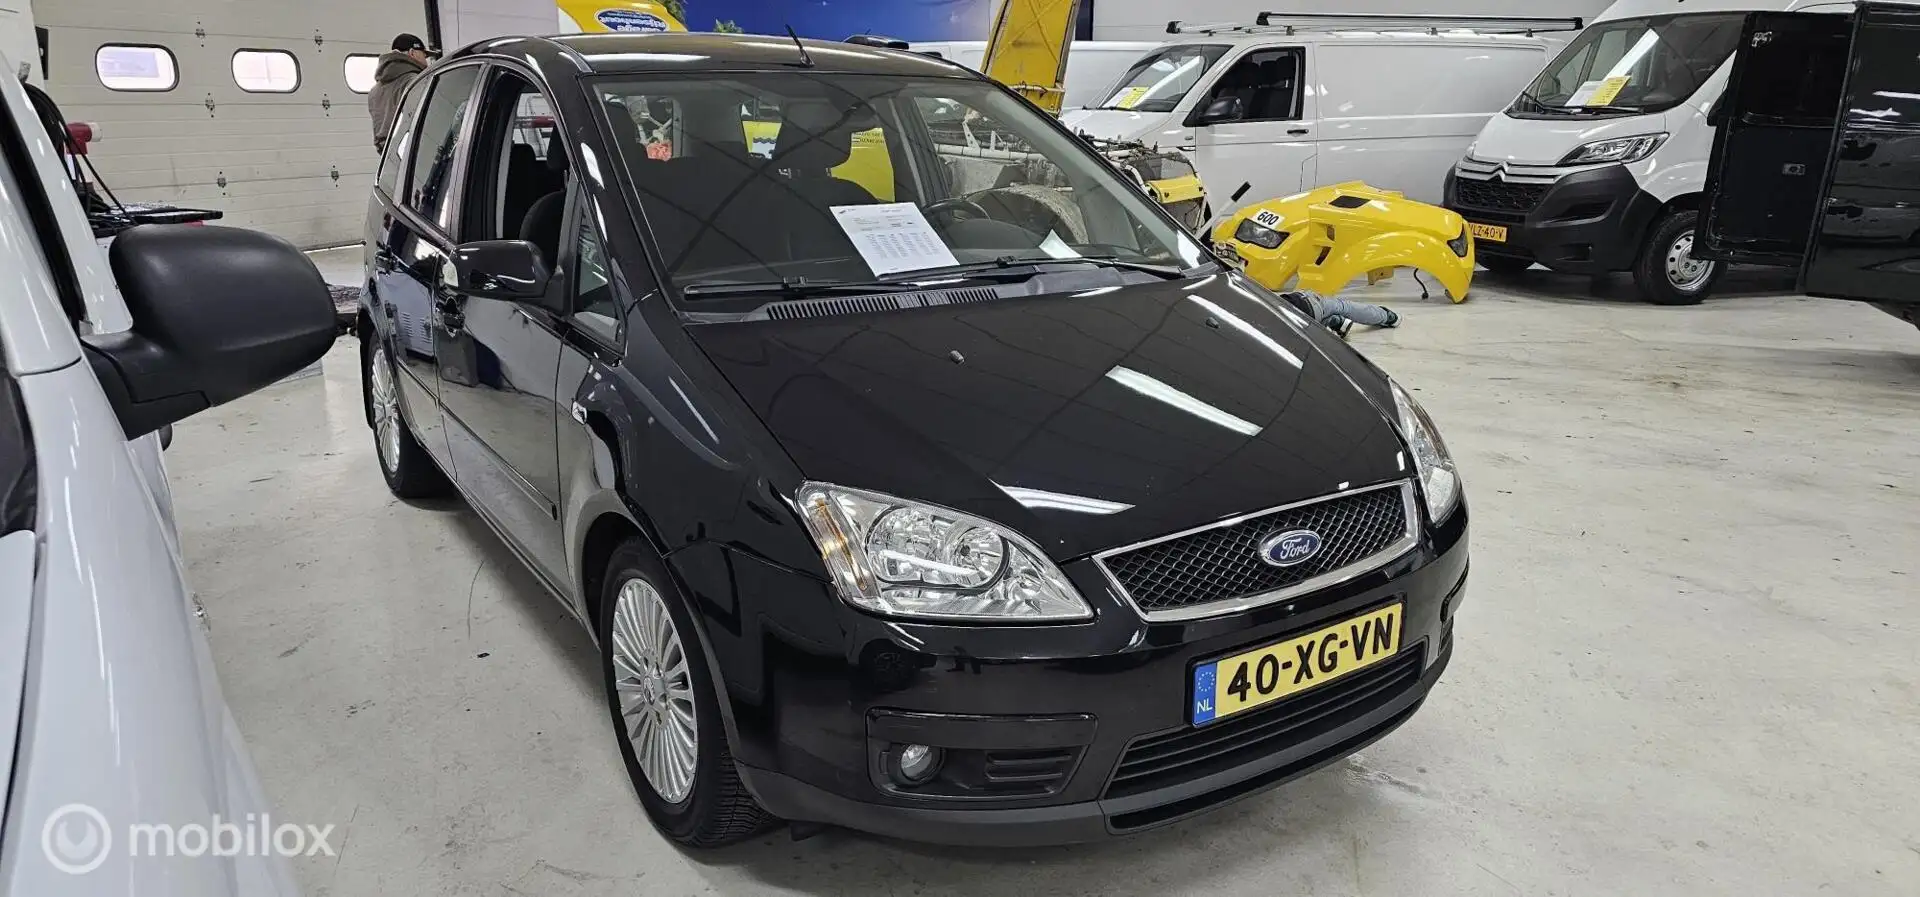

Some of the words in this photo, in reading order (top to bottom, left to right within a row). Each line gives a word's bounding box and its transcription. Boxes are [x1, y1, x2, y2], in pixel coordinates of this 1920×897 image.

[1257, 211, 1280, 225] 600
[1280, 537, 1310, 560] Ford
[1227, 613, 1394, 702] 40-XG-VN
[1197, 698, 1213, 714] NL
